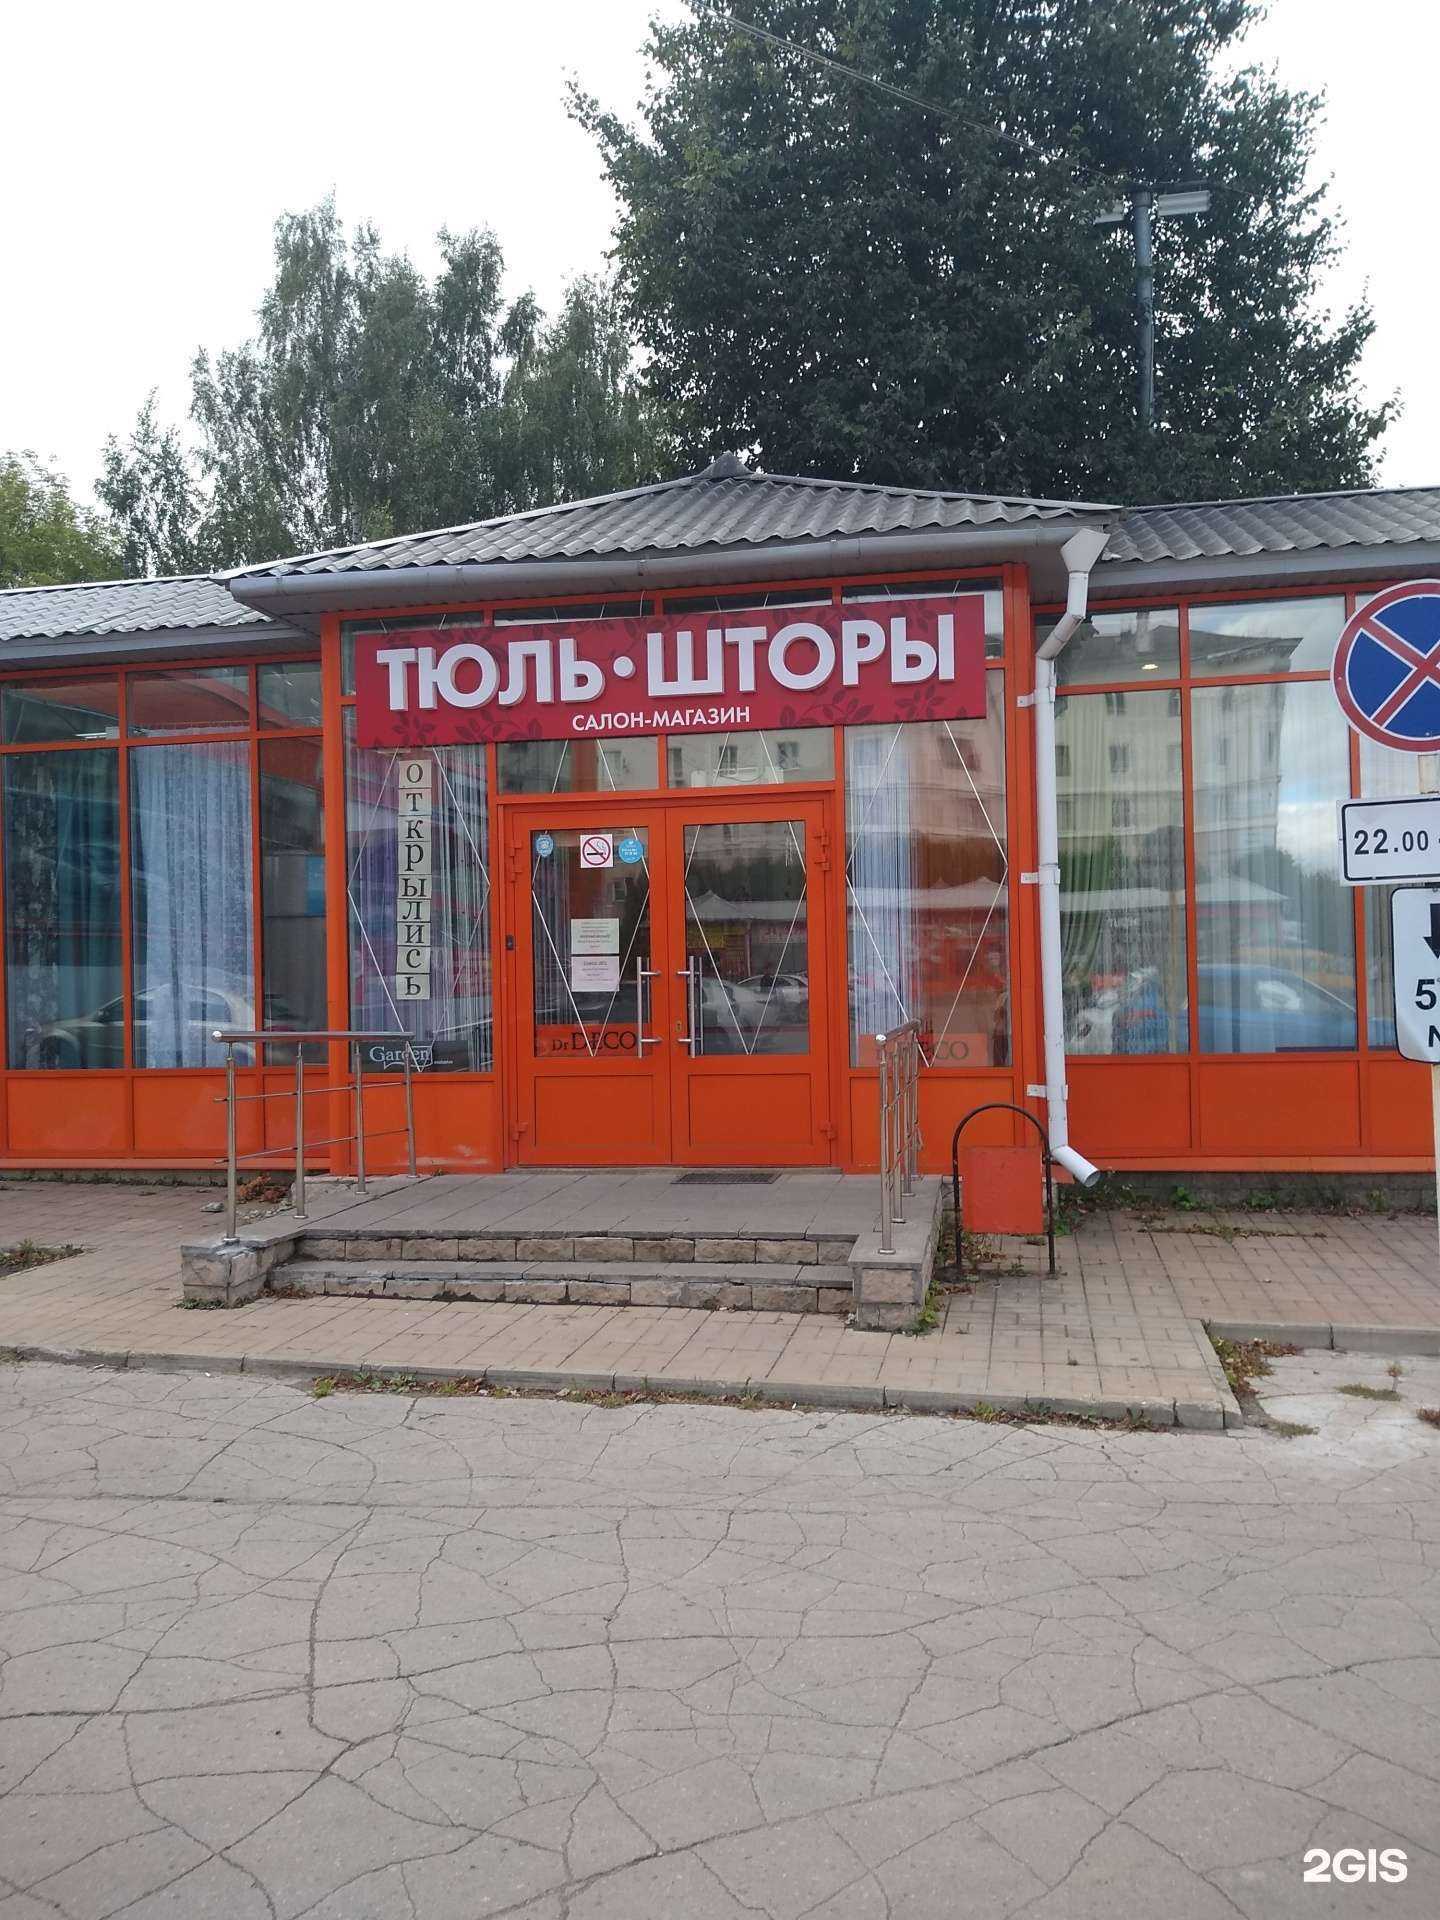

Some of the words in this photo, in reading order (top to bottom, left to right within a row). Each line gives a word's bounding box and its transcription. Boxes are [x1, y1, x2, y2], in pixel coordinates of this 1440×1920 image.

[376, 638, 604, 711] ТЮЛЬ
[645, 613, 955, 697] ШТОРЫ
[571, 706, 751, 732] САЛОН-МАГАЗИН
[1353, 828, 1429, 855] 22.00
[402, 763, 427, 997] ОТКРЫЛИСЬ
